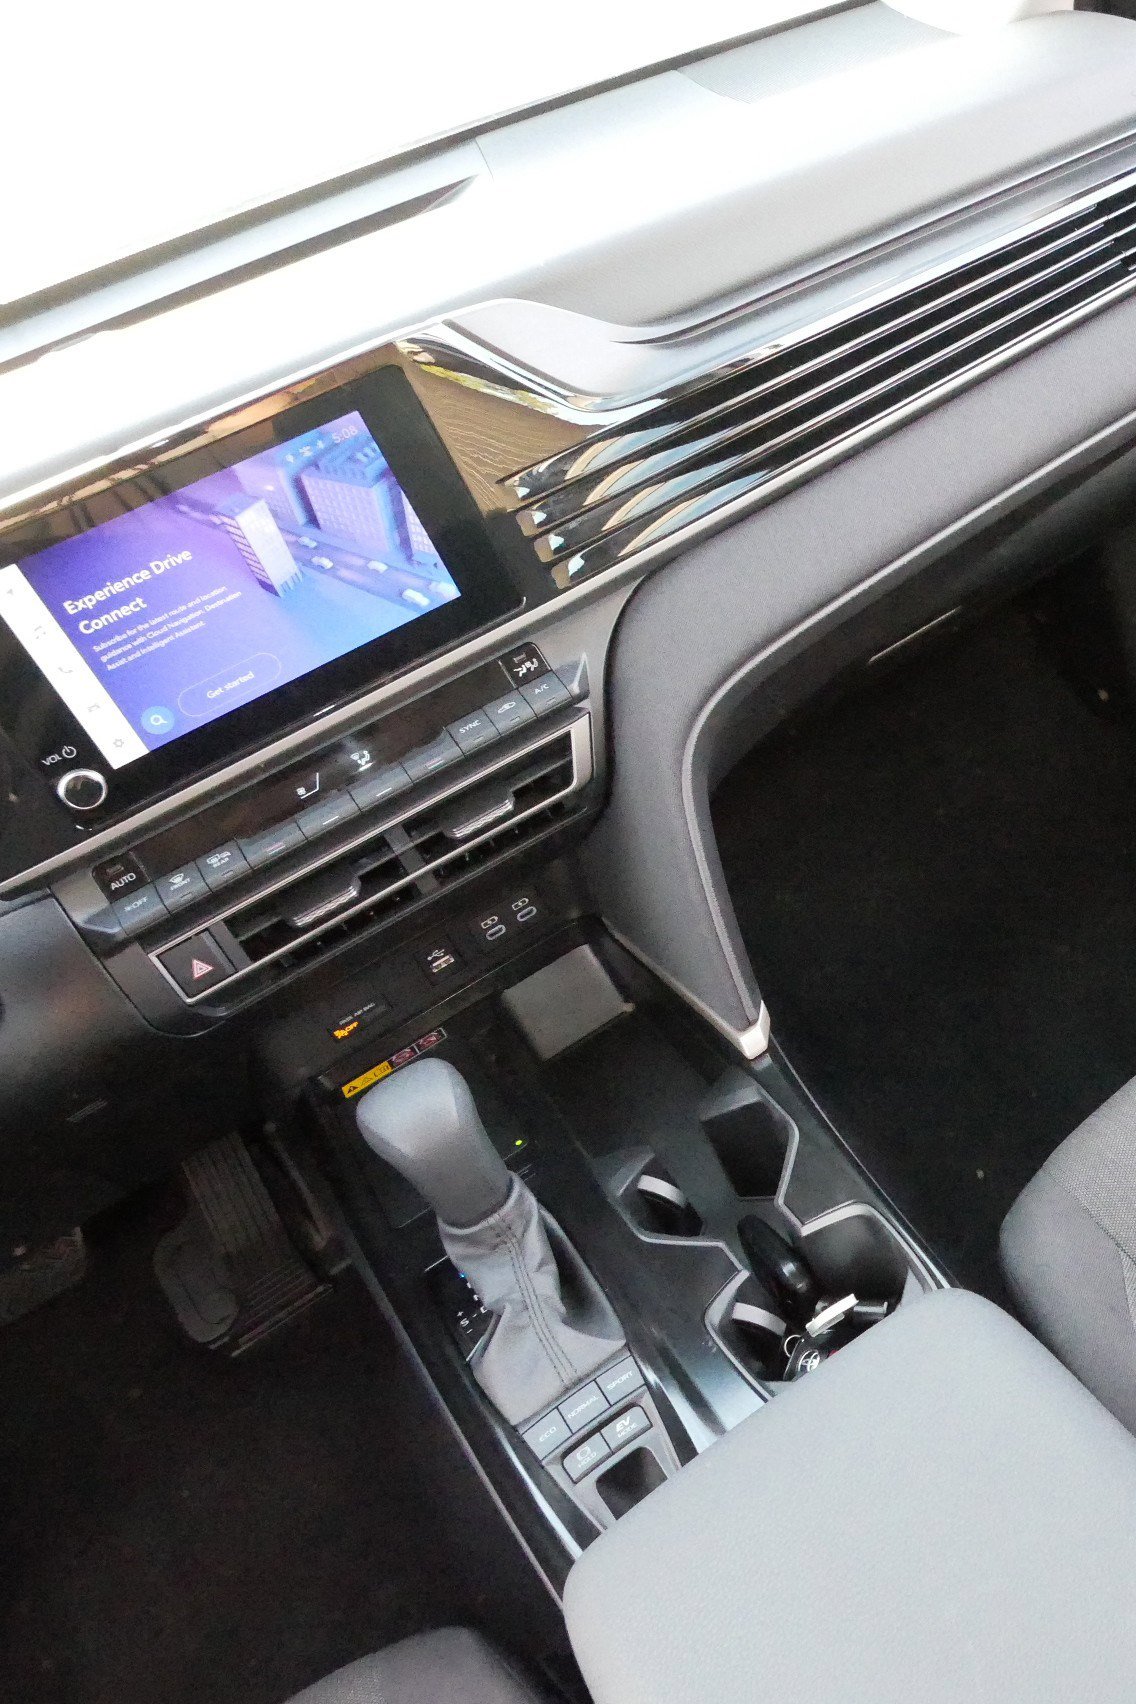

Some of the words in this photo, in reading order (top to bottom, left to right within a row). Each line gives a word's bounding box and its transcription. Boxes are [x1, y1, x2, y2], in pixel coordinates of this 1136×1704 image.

[332, 425, 358, 444] 5:08
[63, 569, 152, 615] Experience
[150, 550, 193, 575] Drive
[78, 597, 148, 634] Connect
[93, 634, 127, 652] Subscribe
[126, 628, 138, 637] for
[137, 622, 149, 632] the
[149, 612, 169, 626] latest
[168, 605, 187, 617] route
[187, 597, 201, 608] and
[200, 586, 228, 602] location
[100, 643, 133, 662] guidance
[132, 635, 147, 647] with
[146, 625, 168, 639] Cloud
[204, 591, 242, 612] Destination
[106, 657, 129, 671] Assist
[127, 651, 142, 662] and
[140, 634, 176, 655] Intelligent
[206, 687, 224, 699] Get
[224, 671, 255, 690] started
[534, 683, 550, 694] A/C
[458, 719, 482, 734] SYNC
[41, 753, 62, 766] VOL
[110, 872, 137, 891] AUTO
[460, 1317, 470, 1327] S
[606, 1370, 634, 1391] SPORT
[567, 1395, 599, 1420] NORMAL
[539, 1426, 557, 1442] ECO
[616, 1416, 631, 1433] EV
